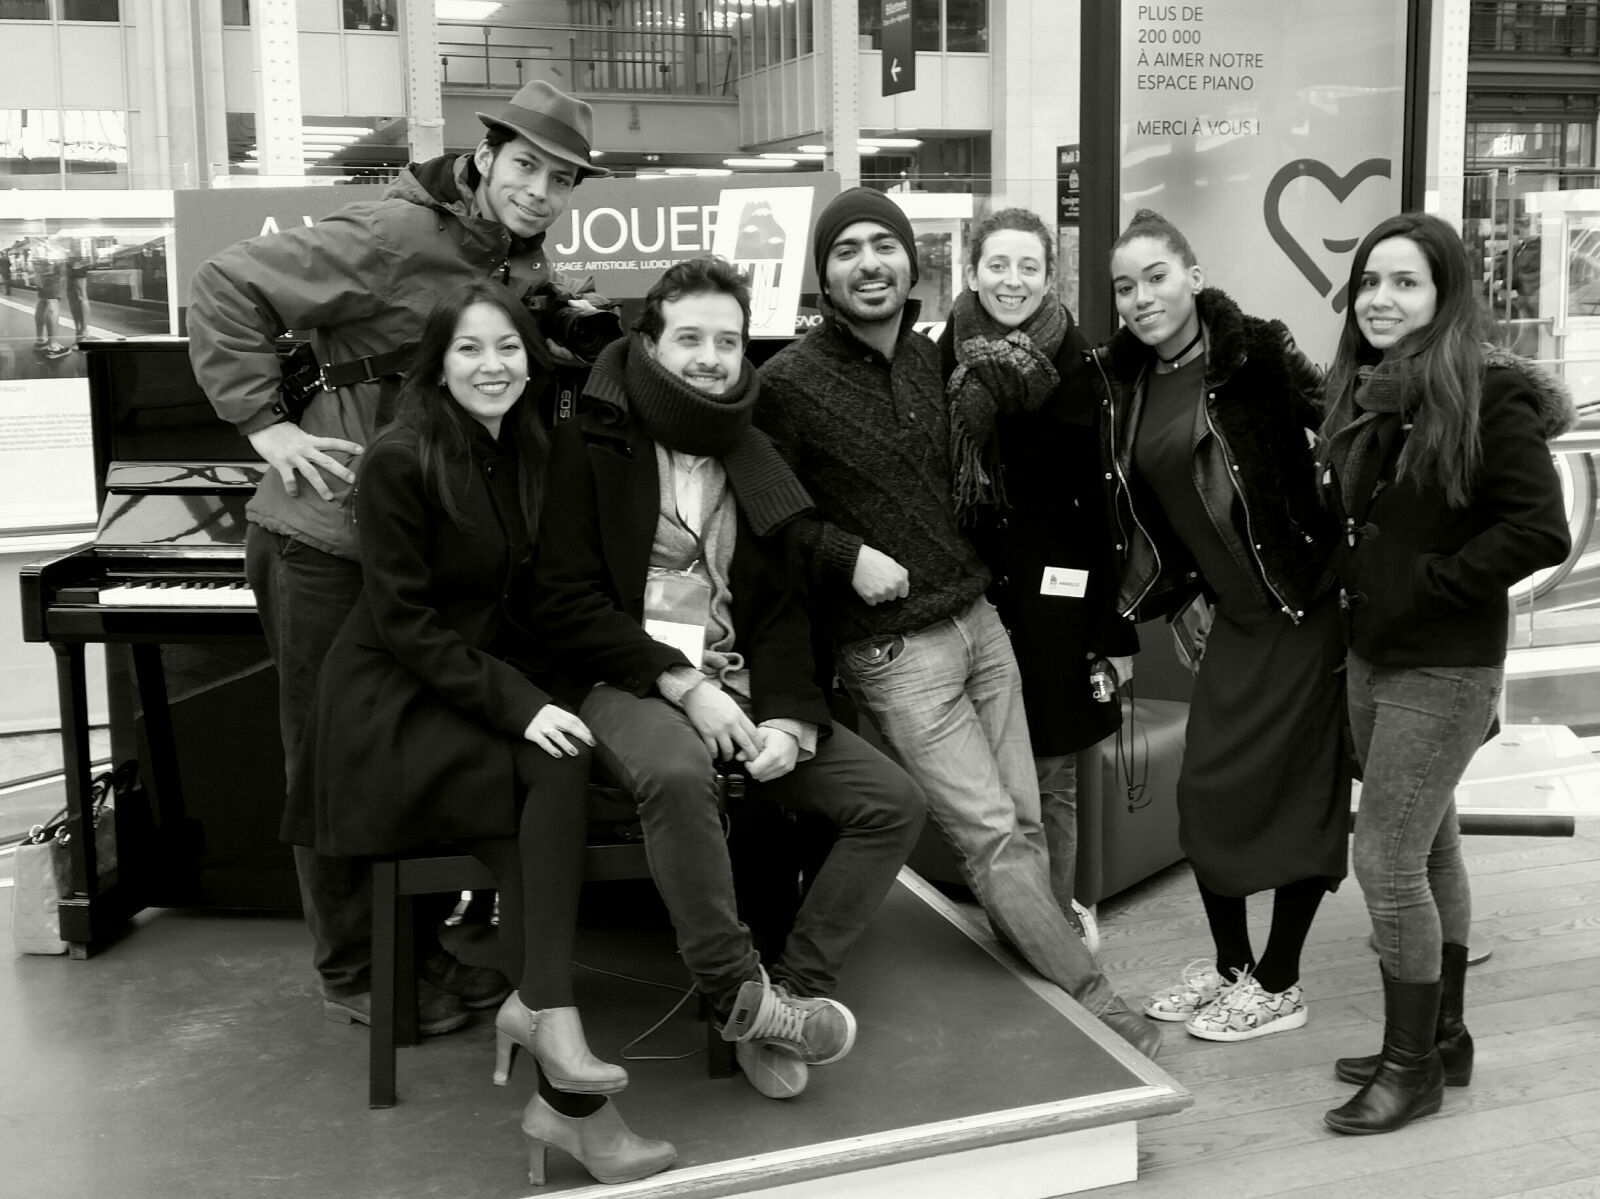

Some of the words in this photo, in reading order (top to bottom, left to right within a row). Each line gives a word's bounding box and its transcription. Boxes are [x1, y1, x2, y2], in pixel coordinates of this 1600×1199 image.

[1138, 5, 1177, 21] PLUS
[1182, 6, 1204, 21] DE
[1138, 28, 1167, 44] 200
[1172, 29, 1201, 44] 000
[1137, 48, 1149, 67] À
[1153, 52, 1204, 67] AIMER
[1209, 52, 1264, 68] NOTRE
[1137, 74, 1198, 90] ESPACE
[1203, 75, 1254, 91] PIANO
[1137, 120, 1187, 136] MERCI
[1192, 116, 1203, 136] À
[1207, 120, 1252, 136] VOUS
[560, 389, 571, 418] EOS
